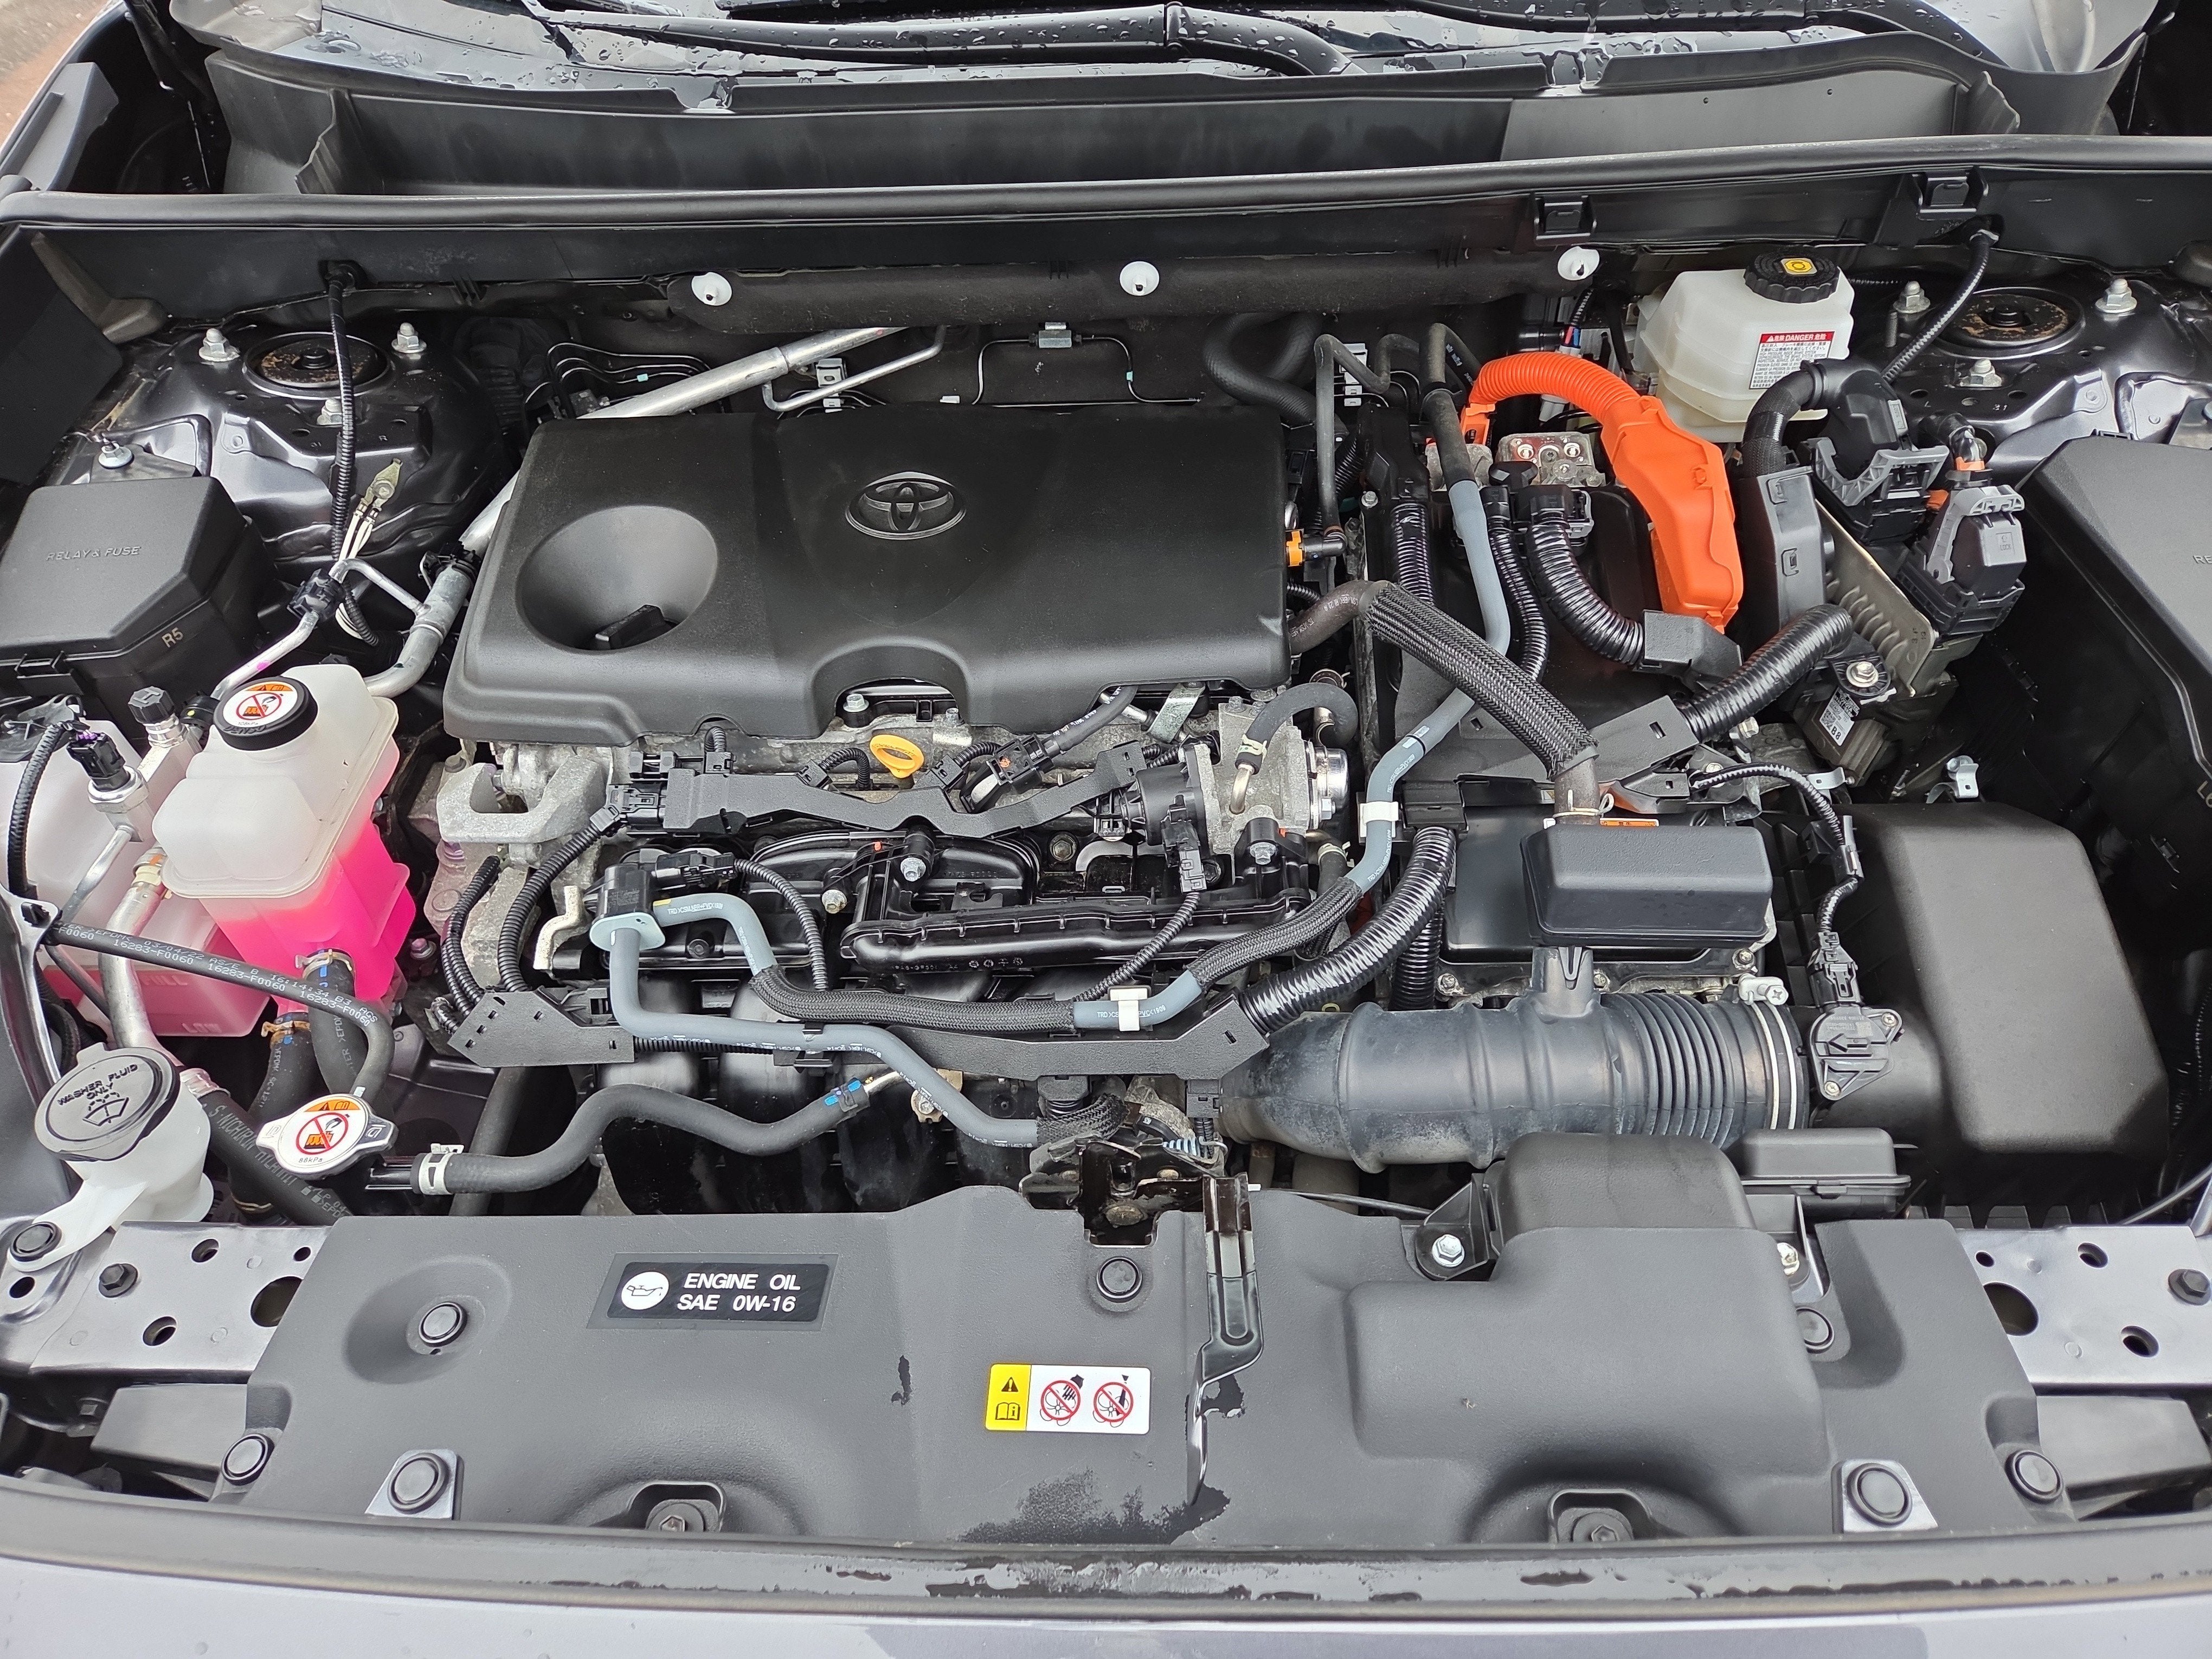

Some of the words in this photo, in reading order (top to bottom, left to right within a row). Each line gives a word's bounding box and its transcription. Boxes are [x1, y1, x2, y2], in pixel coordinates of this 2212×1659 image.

[45, 549, 91, 561] RELAY
[105, 545, 142, 557] FUSE
[161, 627, 184, 648] R5
[133, 687, 161, 705] H
[144, 940, 205, 960] 03/04/22
[250, 968, 259, 976] B
[271, 974, 330, 998] 16:14:34
[335, 995, 353, 1006] B3
[113, 939, 194, 965] 16283-F0060
[207, 963, 286, 992] 16283-F0060
[299, 991, 371, 1027] 16283-F0060
[57, 1080, 103, 1105] WASHER
[108, 1064, 138, 1081] FLUID
[86, 1082, 113, 1100] ONLY
[683, 1273, 759, 1290] ENGINE
[769, 1274, 802, 1290] OIL
[677, 1294, 721, 1311] SAE
[732, 1295, 796, 1312] 0W-16
